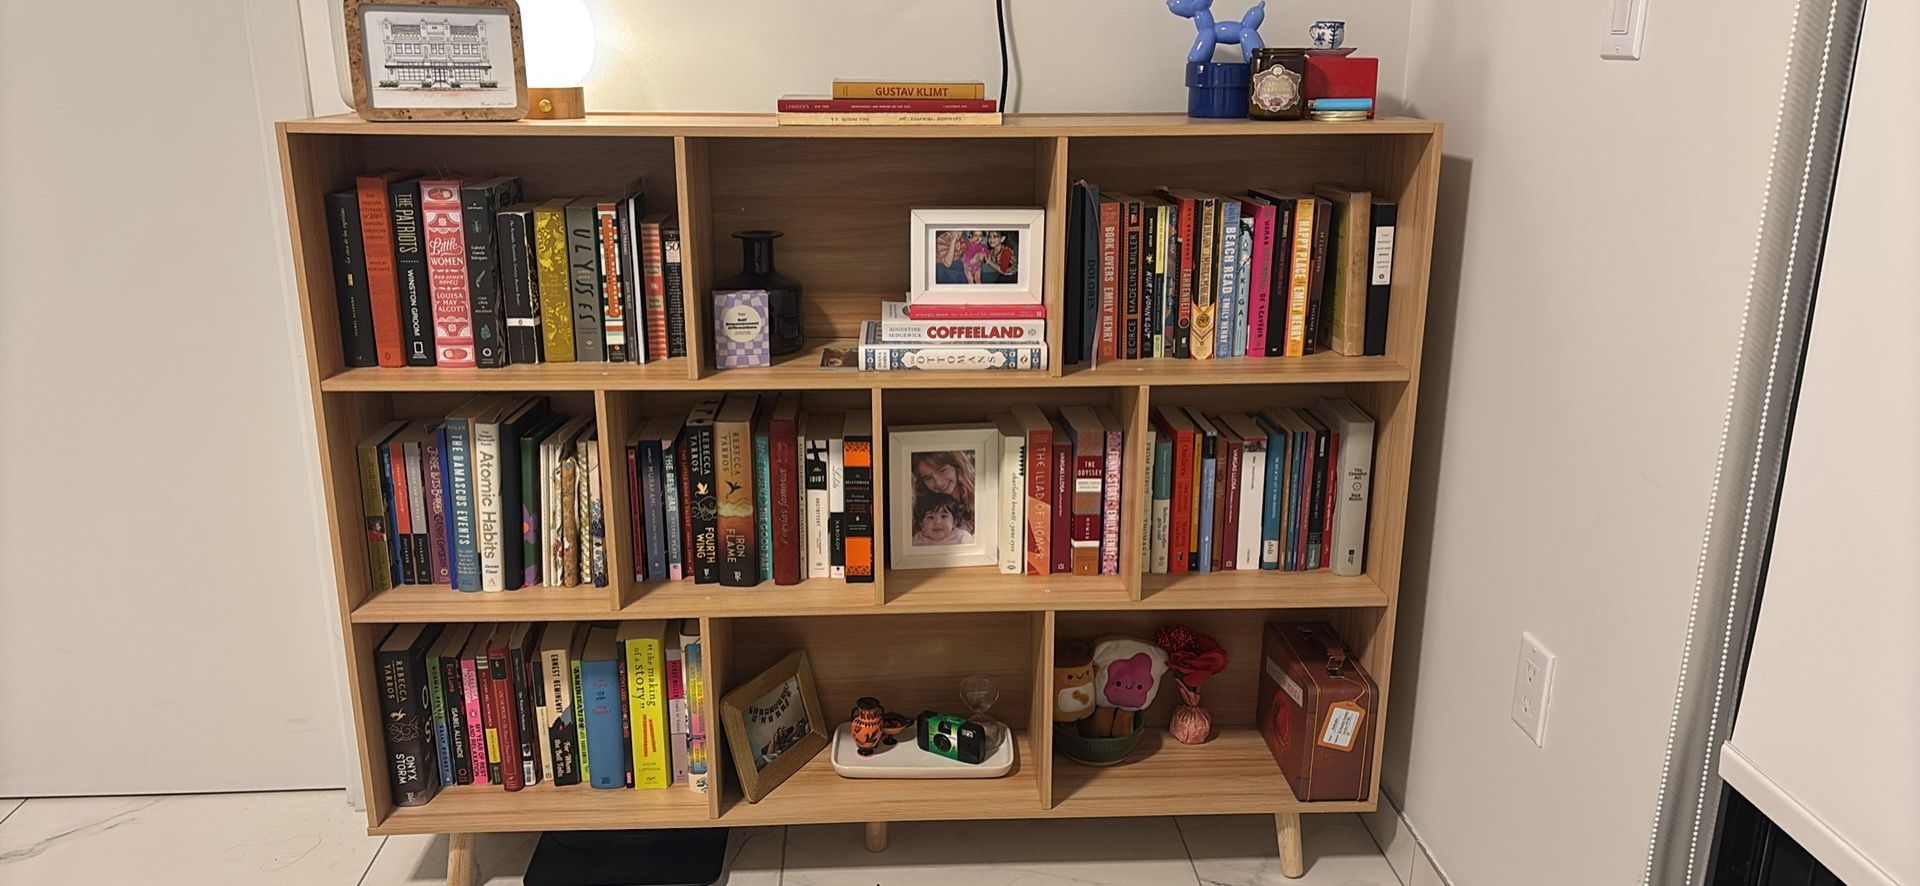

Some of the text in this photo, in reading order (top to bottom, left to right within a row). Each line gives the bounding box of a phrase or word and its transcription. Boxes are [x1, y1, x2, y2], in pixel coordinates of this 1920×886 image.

[875, 88, 948, 97] GUSTAV KLIMT
[395, 194, 417, 253] THE PATRIOTS
[430, 237, 462, 255] Little
[431, 257, 463, 265] WOMEN
[608, 219, 612, 228] TO
[611, 261, 619, 314] MOCKINGBIRD
[666, 242, 680, 251] 50
[1222, 227, 1237, 294] BEACH READ
[1294, 220, 1310, 279] HAPPY PLACE
[573, 228, 595, 322] ULYSSES
[1087, 259, 1096, 310] DOLORES
[1103, 226, 1114, 342] BOOK LOVERS EMILY HENRY
[1128, 235, 1137, 312] MADELINE MILLER
[1181, 268, 1191, 314] FAHRENHEIT
[407, 269, 420, 336] WINSTON GROOM
[1144, 296, 1153, 339] VONNEGUT
[1220, 298, 1230, 343] EMILY HENRY
[1290, 286, 1304, 342] EMILY HENRY
[927, 326, 1024, 339] COFFEELAND
[917, 356, 996, 364] OTTOMANS
[451, 435, 464, 452] THE
[690, 435, 700, 472] YARROS
[701, 431, 711, 476] REBECCA
[720, 435, 730, 472] YARROS
[732, 432, 741, 476] REBECCA
[1180, 444, 1189, 477] Outliers
[426, 446, 443, 514] JORGE LUIS BORGES
[452, 455, 468, 507] DAMASCUS
[479, 451, 496, 507] Atomic
[648, 466, 656, 507] MURAKAMI
[665, 453, 676, 513] THE BELL JAR
[809, 475, 825, 483] IDIOT
[832, 465, 840, 488] Lolita
[1107, 450, 1120, 500] FUNNY STORY
[1034, 447, 1046, 560] THE ILIAD OF HOMER
[456, 510, 470, 545] EVENTS
[482, 511, 498, 559] Habits
[696, 533, 706, 559] WING
[704, 527, 716, 563] FOURTH
[725, 528, 737, 563] FLAME
[735, 535, 745, 558] IRON
[759, 507, 770, 572] THE GOOD PART
[1106, 510, 1119, 556] EMILY HENRY
[634, 647, 641, 656] of
[384, 663, 394, 699] YARROS
[395, 660, 407, 703] REBECCA
[431, 665, 443, 720] NORMAL PEOPLE
[462, 668, 472, 704] MOSHFEGH
[469, 670, 478, 700] OTTESSA
[551, 654, 563, 714] ERNEST HEMINGWAY
[574, 667, 586, 730] ANNIHILATION
[646, 667, 657, 707] making
[438, 725, 446, 744] SALLY
[451, 707, 463, 759] ISABEL ALLENDE
[475, 723, 481, 734] MY
[478, 752, 485, 762] OF
[395, 753, 407, 785] STORM
[406, 755, 417, 781] ONYX
[470, 739, 479, 777] RELAXATION
[554, 739, 564, 778] the Bell Tolls
